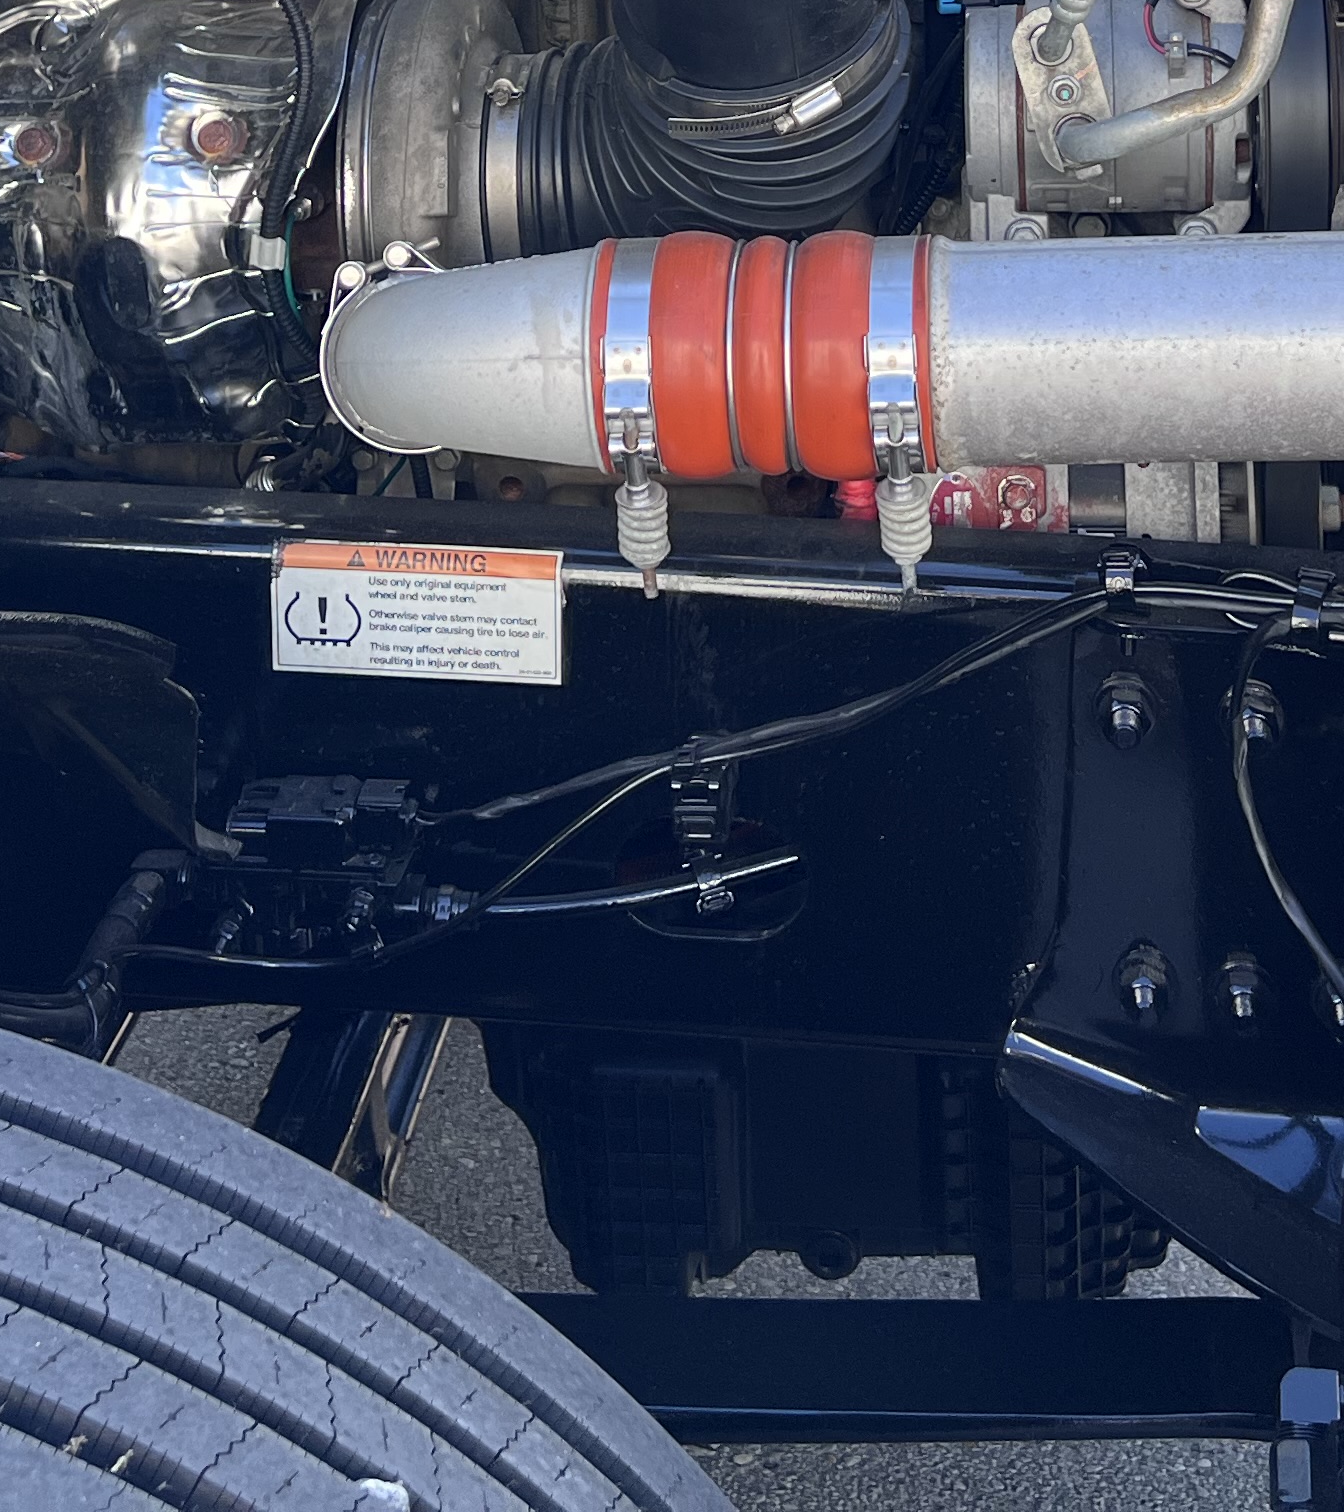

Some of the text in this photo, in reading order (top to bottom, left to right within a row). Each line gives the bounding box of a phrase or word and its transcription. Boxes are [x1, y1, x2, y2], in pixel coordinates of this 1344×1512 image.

[375, 549, 487, 573] WARNING
[368, 576, 507, 594] Use only original equipment
[368, 590, 477, 604] wheel and valve stem.
[368, 609, 537, 626] Otherwise valve stem may contact
[369, 622, 548, 639] brake caliper causing tire to lose air.
[370, 642, 520, 658] This may affect vehicle control
[370, 656, 501, 670] resulting in injury or death.
